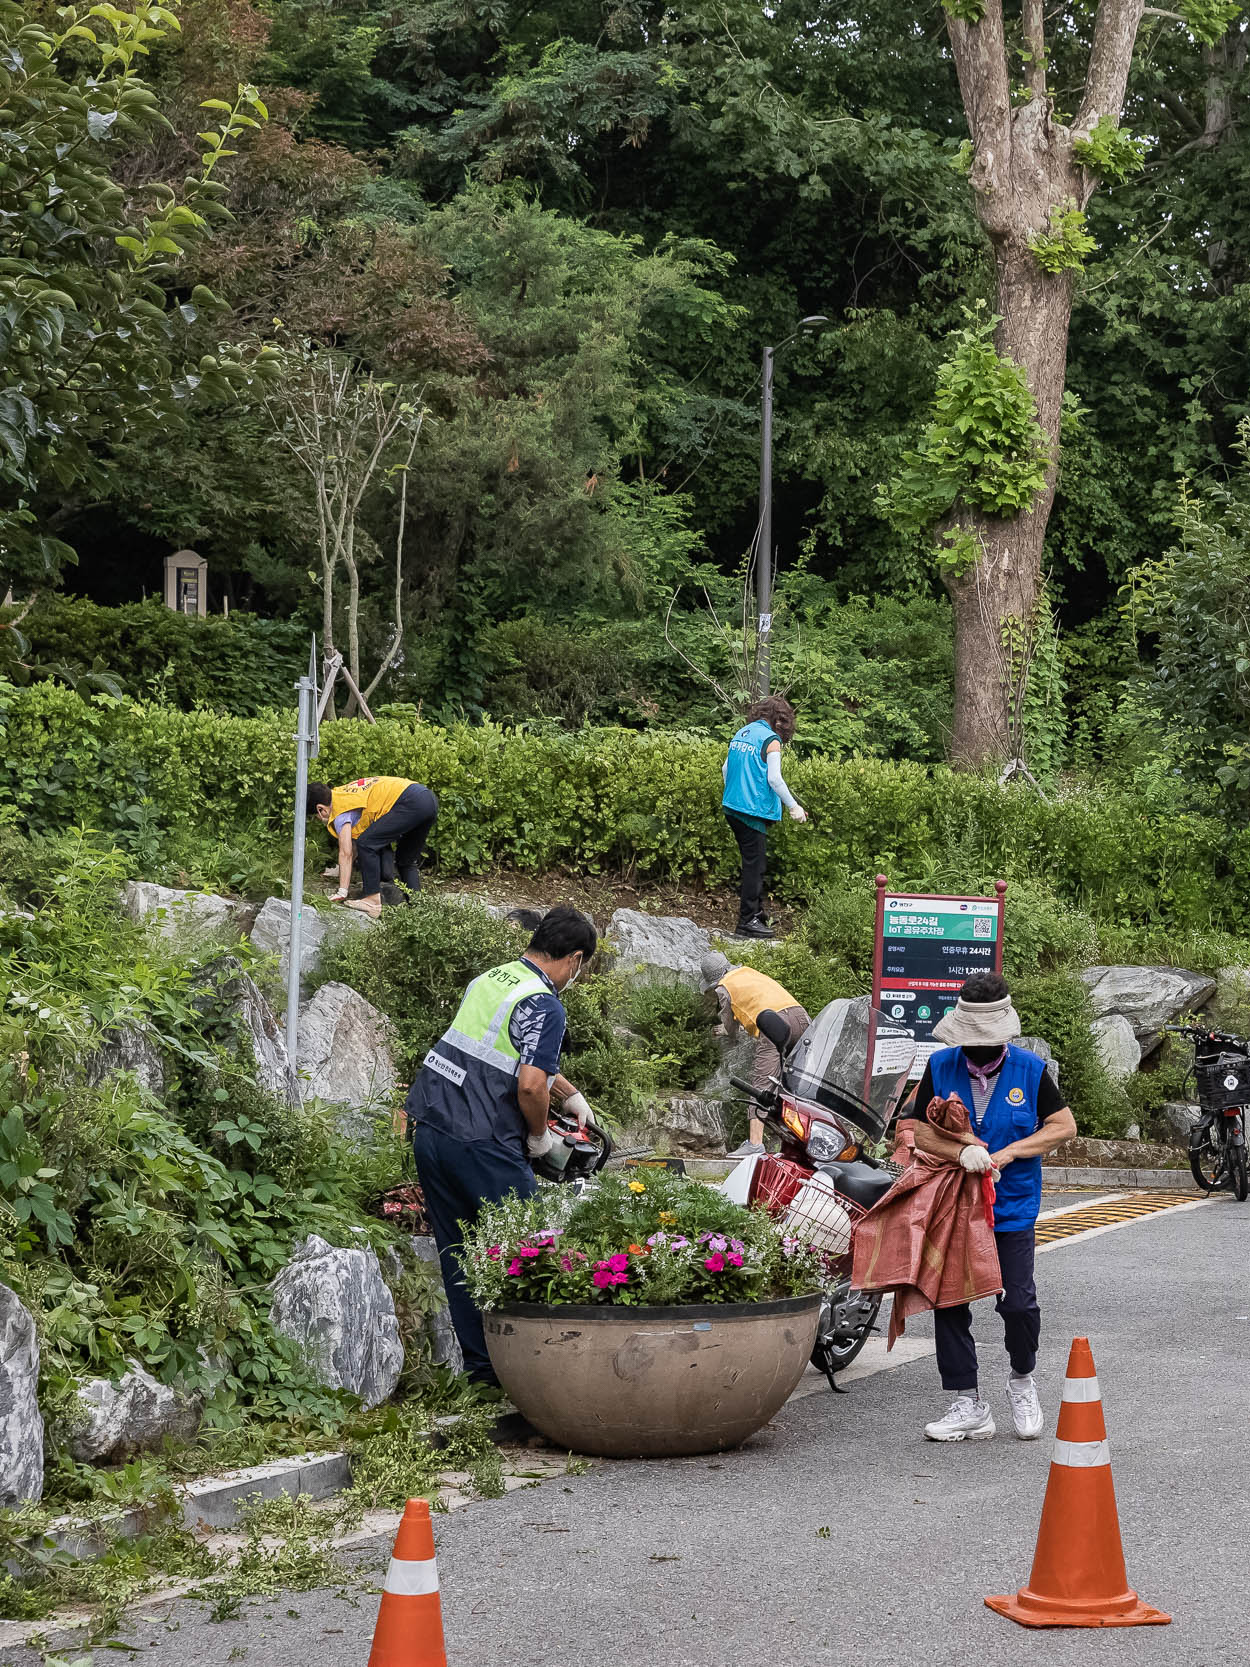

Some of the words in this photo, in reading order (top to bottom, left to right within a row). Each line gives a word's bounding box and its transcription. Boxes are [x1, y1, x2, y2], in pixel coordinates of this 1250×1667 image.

[889, 914, 939, 927] 능동로24길
[888, 925, 902, 935] IoT
[904, 925, 945, 937] 공유주차장
[941, 945, 969, 955] 연중무휴
[968, 947, 991, 956] 24시간
[948, 966, 965, 975] 1시간
[488, 967, 521, 987] 광진구
